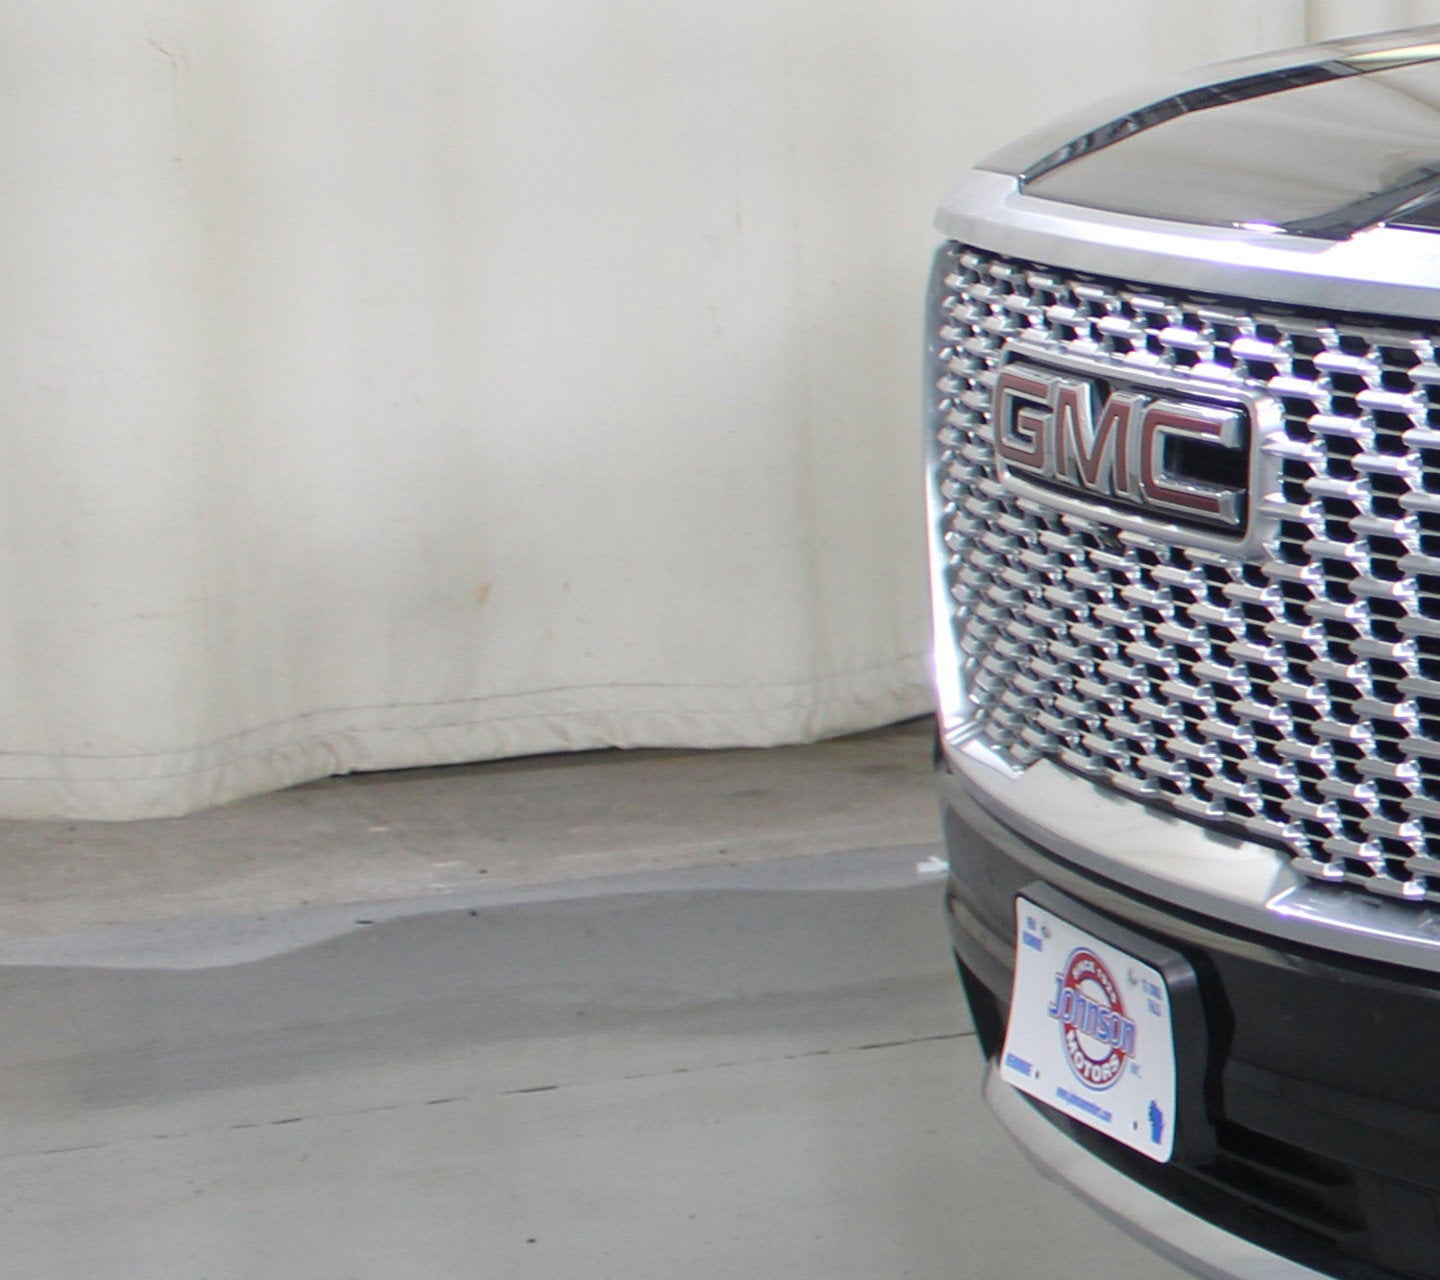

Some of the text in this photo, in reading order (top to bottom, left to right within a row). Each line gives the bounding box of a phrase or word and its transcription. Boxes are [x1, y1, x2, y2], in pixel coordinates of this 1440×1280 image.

[996, 365, 1245, 526] GMC
[1048, 972, 1137, 1058] Johnson
[1066, 1028, 1121, 1081] MOTORS
